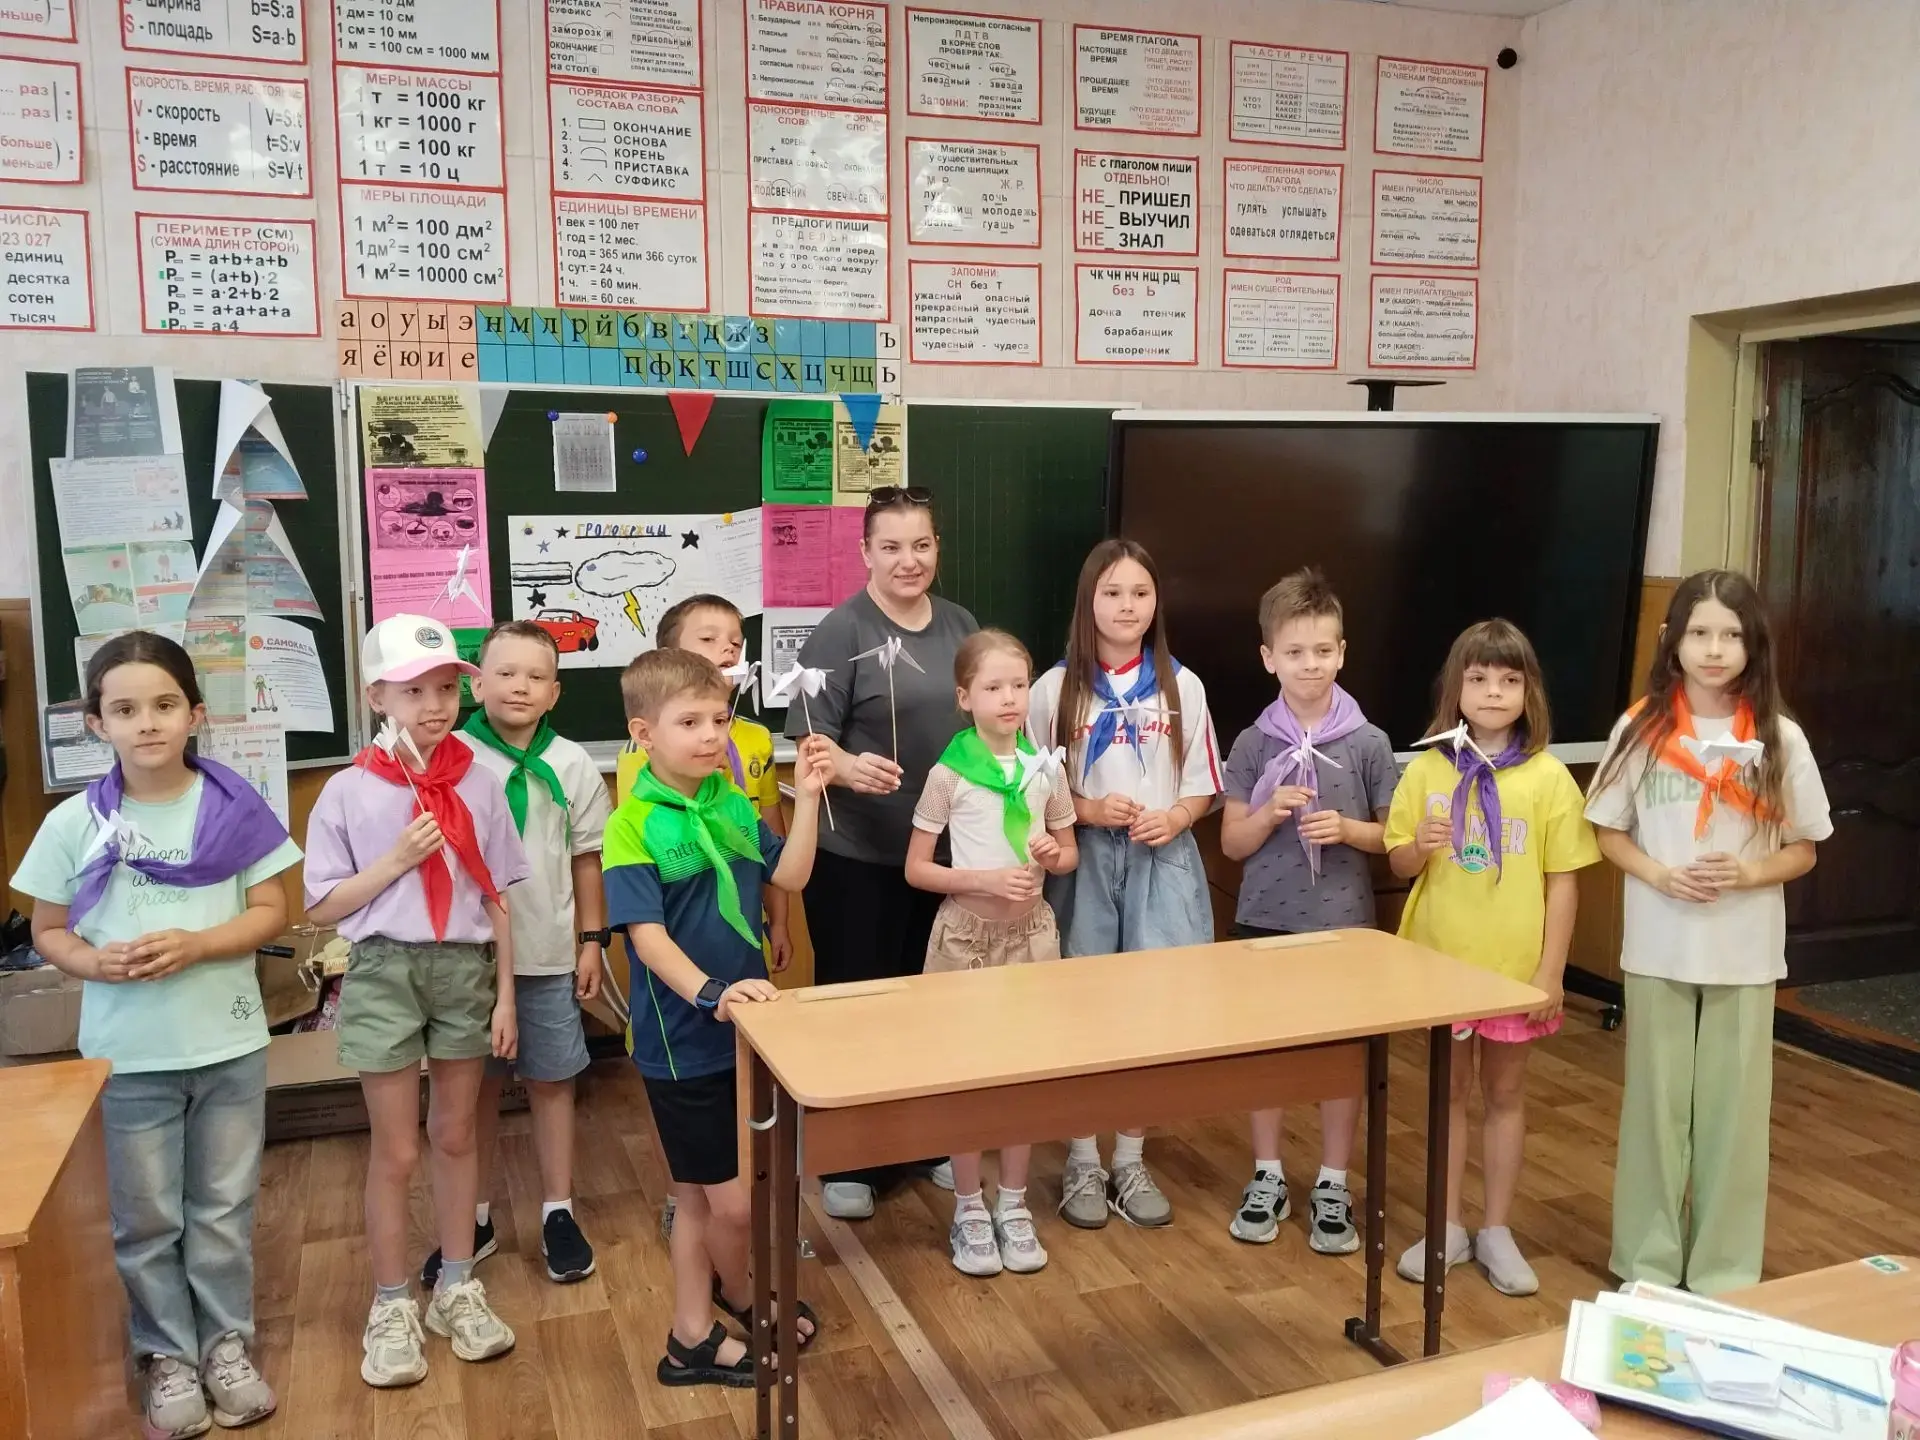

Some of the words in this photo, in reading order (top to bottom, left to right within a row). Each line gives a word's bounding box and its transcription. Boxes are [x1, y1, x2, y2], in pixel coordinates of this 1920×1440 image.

[549, 6, 592, 16] СУФФИКС
[760, 0, 825, 15] ПРАВИЛА
[829, 6, 875, 20] КОРНЯ
[913, 14, 986, 28] Непроизносимые
[988, 22, 1031, 32] согласные
[148, 21, 213, 41] площадь
[949, 40, 976, 49] КОРНЕ
[978, 42, 1000, 50] СЛОВ
[1100, 32, 1134, 43] ВРЕМЯ
[1136, 36, 1179, 47] ГЛАГОЛА
[381, 42, 402, 53] 100
[438, 46, 467, 59] 1000
[550, 41, 598, 53] ОКОНЧАНИЕ
[1080, 45, 1127, 56] НАСТОЯЩЕЕ
[1090, 55, 1118, 64] ВРЕМЯ
[1249, 48, 1291, 59] ЧАСТИ
[1300, 53, 1332, 63] РЕЧИ
[366, 73, 411, 87] МЕРЫ
[416, 76, 472, 91] МАССЫ
[1080, 76, 1130, 87] ПРОШЕДШЕЕ
[1393, 72, 1426, 81] ЧЛЕНАМ
[416, 91, 461, 109] 1000
[468, 98, 486, 111] кг
[569, 87, 628, 100] ПОРЯДОК
[632, 92, 686, 105] РАЗБОРА
[577, 99, 634, 111] СОСТАВА
[637, 103, 679, 115] СЛОВА
[1080, 107, 1117, 117] БУДУЩЕЕ
[156, 109, 221, 124] скорость
[374, 116, 393, 128] кг
[417, 115, 461, 132] 1000
[613, 122, 692, 137] ОКОНЧАНИЕ
[153, 132, 197, 149] время
[614, 135, 668, 148] ОСНОВА
[418, 139, 450, 157] 100
[458, 145, 476, 158] кг
[614, 148, 665, 161] КОРЕНЬ
[940, 144, 975, 156] Мягкий
[753, 155, 794, 166] ПРИСТАВКА
[937, 155, 1018, 166] существительных
[1080, 155, 1096, 167] НЕ
[1110, 158, 1159, 171] глаголом
[1162, 163, 1192, 173] пиши
[159, 158, 240, 178] расстояние
[419, 163, 440, 179] 10
[614, 161, 689, 176] ПРИСТАВКА
[938, 165, 965, 173] после
[967, 165, 1009, 175] шипящих
[1230, 164, 1305, 175] НЕОПРЕДЕЛЕННАЯ
[1307, 168, 1336, 177] ФОРМА
[615, 174, 676, 188] СУФФИКС
[1104, 172, 1170, 186] ОТДЕЛЬНО!
[1265, 176, 1301, 185] ГЛАГОЛА
[1247, 184, 1280, 193] ДЕЛАТЬ?
[1298, 187, 1337, 197] СДЕЛАТЬ?
[361, 189, 405, 202] МЕРЫ
[410, 193, 487, 208] ПЛОЩАДИ
[1120, 190, 1190, 208] ПРИШЕЛ
[559, 201, 629, 216] ЕДИНИЦЫ
[633, 205, 697, 219] ВРЕМЕНИ
[1237, 203, 1268, 215] гулять
[1282, 205, 1327, 218] услышать
[566, 218, 585, 228] век
[600, 218, 617, 229] 100
[621, 221, 639, 230] лет
[772, 216, 832, 229] ПРЕДЛОГИ
[836, 220, 869, 232] ПИШИ
[1120, 211, 1190, 229] ВЫУЧИЛ
[157, 223, 251, 236] ПЕРИМЕТР
[257, 226, 293, 240] (СМ)
[416, 219, 449, 235] 100
[1230, 226, 1276, 238] одеваться
[1280, 228, 1336, 241] оглядеться
[25, 233, 51, 247] 027
[151, 235, 201, 249] (СУММА
[207, 239, 240, 250] ДЛИН
[244, 240, 300, 254] СТОРОН)
[566, 233, 586, 244] год
[600, 234, 611, 244] 12
[1119, 232, 1164, 249] ЗНАЛ
[417, 242, 450, 259] 100
[600, 249, 618, 259] 365
[622, 252, 642, 261] или
[646, 251, 664, 261] 366
[668, 254, 697, 265] суток
[5, 252, 63, 265] единиц
[417, 266, 468, 284] 10000
[600, 263, 612, 274] 24
[951, 267, 997, 277] ЗАПОМНИ
[7, 273, 70, 286] десятка
[601, 278, 613, 289] 60
[970, 280, 988, 290] без
[915, 291, 962, 301] ужасный
[985, 294, 1030, 303] опасный
[1112, 285, 1135, 296] без
[1255, 285, 1335, 296] СУЩЕСТВИТЕЛЬНЫХ
[8, 292, 54, 304] сотен
[601, 293, 613, 304] 60
[915, 304, 979, 313] прекрасный
[985, 306, 1029, 314] вкусный
[1089, 308, 1122, 317] дочка
[1143, 309, 1186, 318] птенчик
[10, 312, 55, 324] тысяч
[915, 315, 974, 324] напрасный
[985, 317, 1036, 326] чудесный
[915, 326, 979, 336] интересный
[1104, 327, 1174, 338] барабанщик
[922, 340, 974, 350] чудесный
[1105, 345, 1170, 356] скворечник
